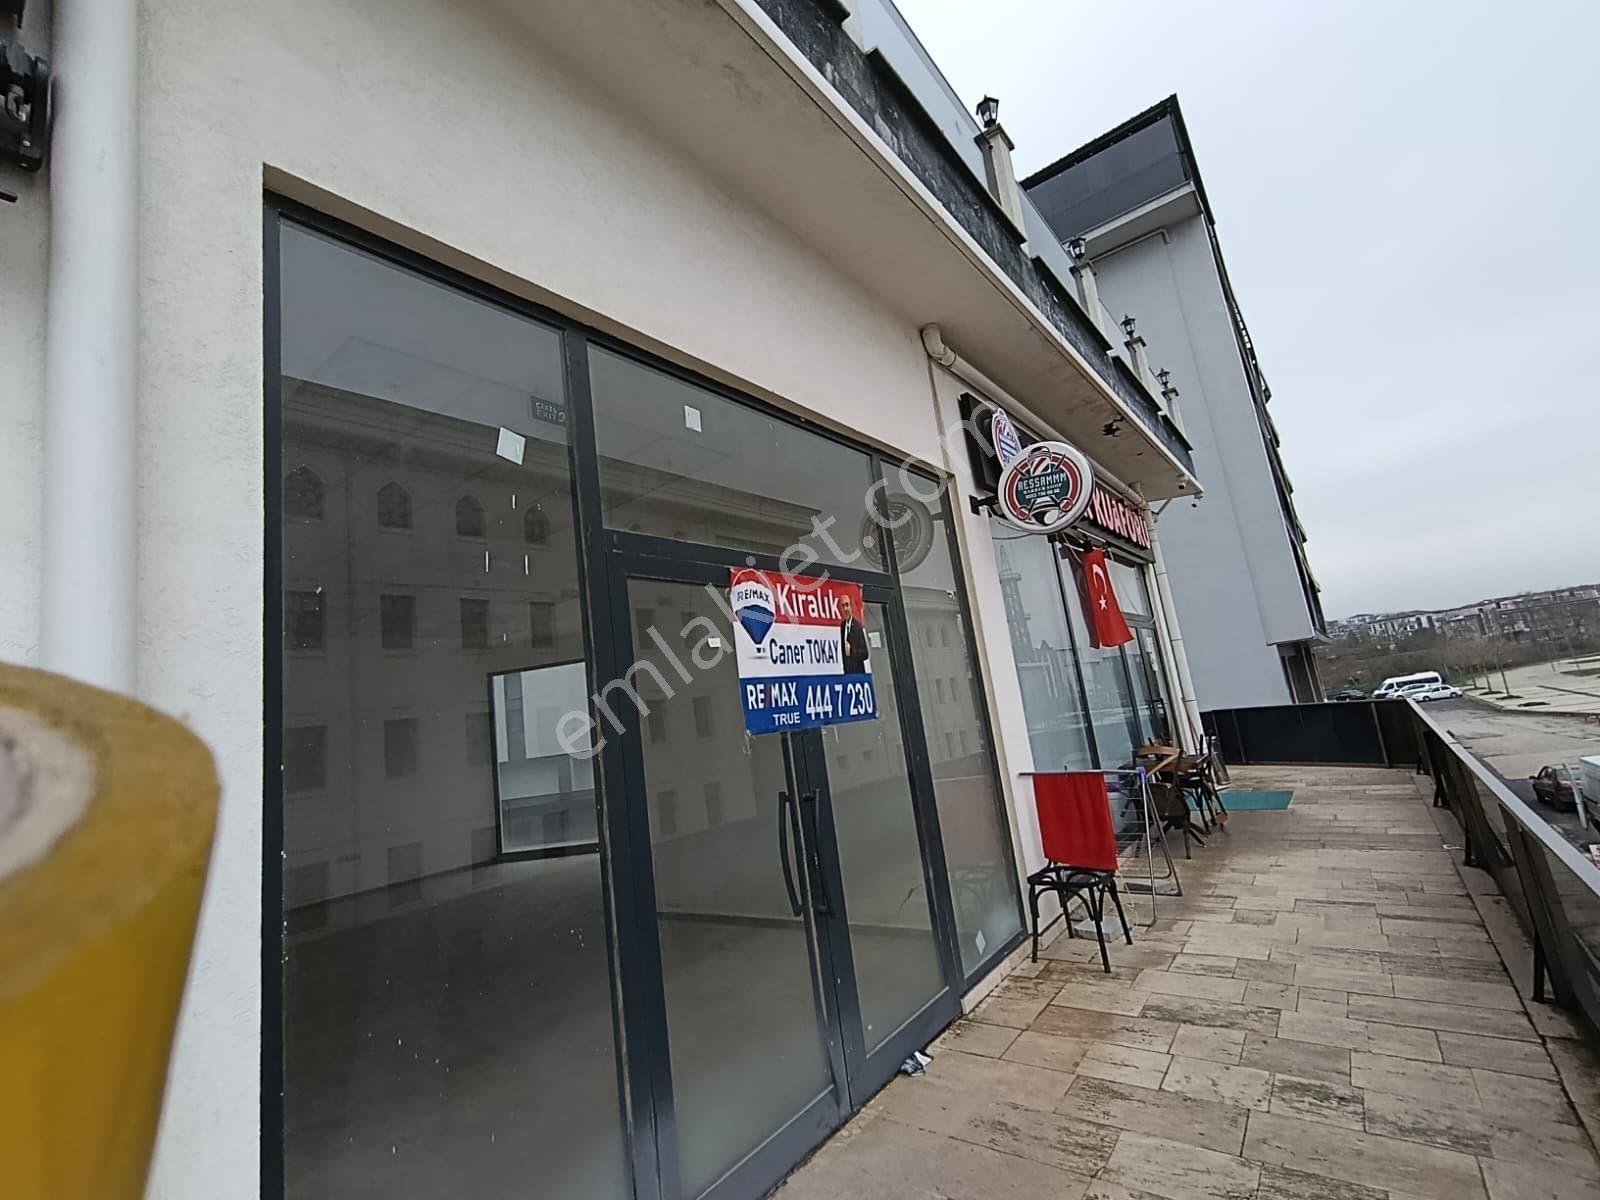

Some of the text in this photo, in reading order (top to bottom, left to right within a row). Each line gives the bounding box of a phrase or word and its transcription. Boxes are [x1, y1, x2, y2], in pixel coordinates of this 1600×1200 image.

[736, 585, 771, 604] RE/MAX
[775, 583, 842, 620] Kiralık
[769, 638, 840, 665] Caner TOKAY
[805, 682, 874, 721] 444 7 230
[773, 712, 801, 726] TRUE
